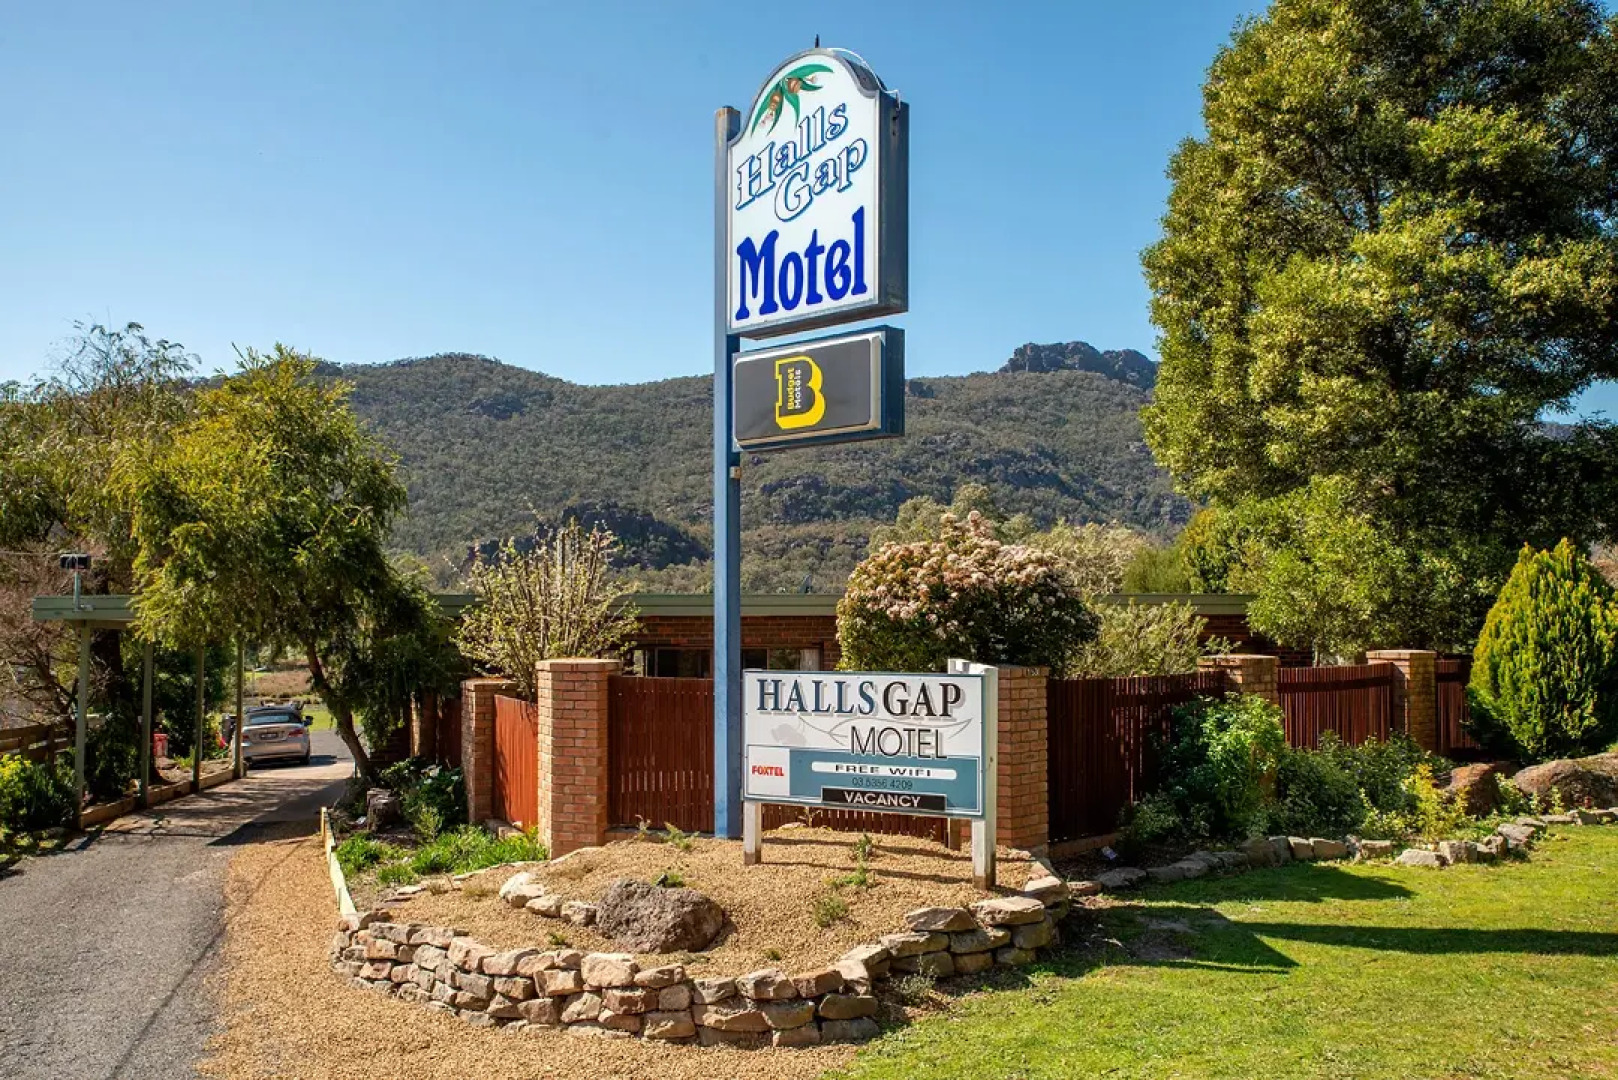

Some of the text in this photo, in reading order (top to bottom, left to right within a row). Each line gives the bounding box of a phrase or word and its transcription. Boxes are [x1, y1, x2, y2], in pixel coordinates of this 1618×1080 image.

[735, 102, 848, 211] Halls
[774, 138, 868, 222] Gap
[735, 205, 868, 321] Motel
[850, 725, 948, 759] MOTEL
[751, 764, 785, 777] FOXTEL
[835, 764, 931, 777] FREE WIFI
[852, 777, 865, 787] 03
[889, 779, 913, 790] 4209
[844, 791, 921, 807] VACANCY
